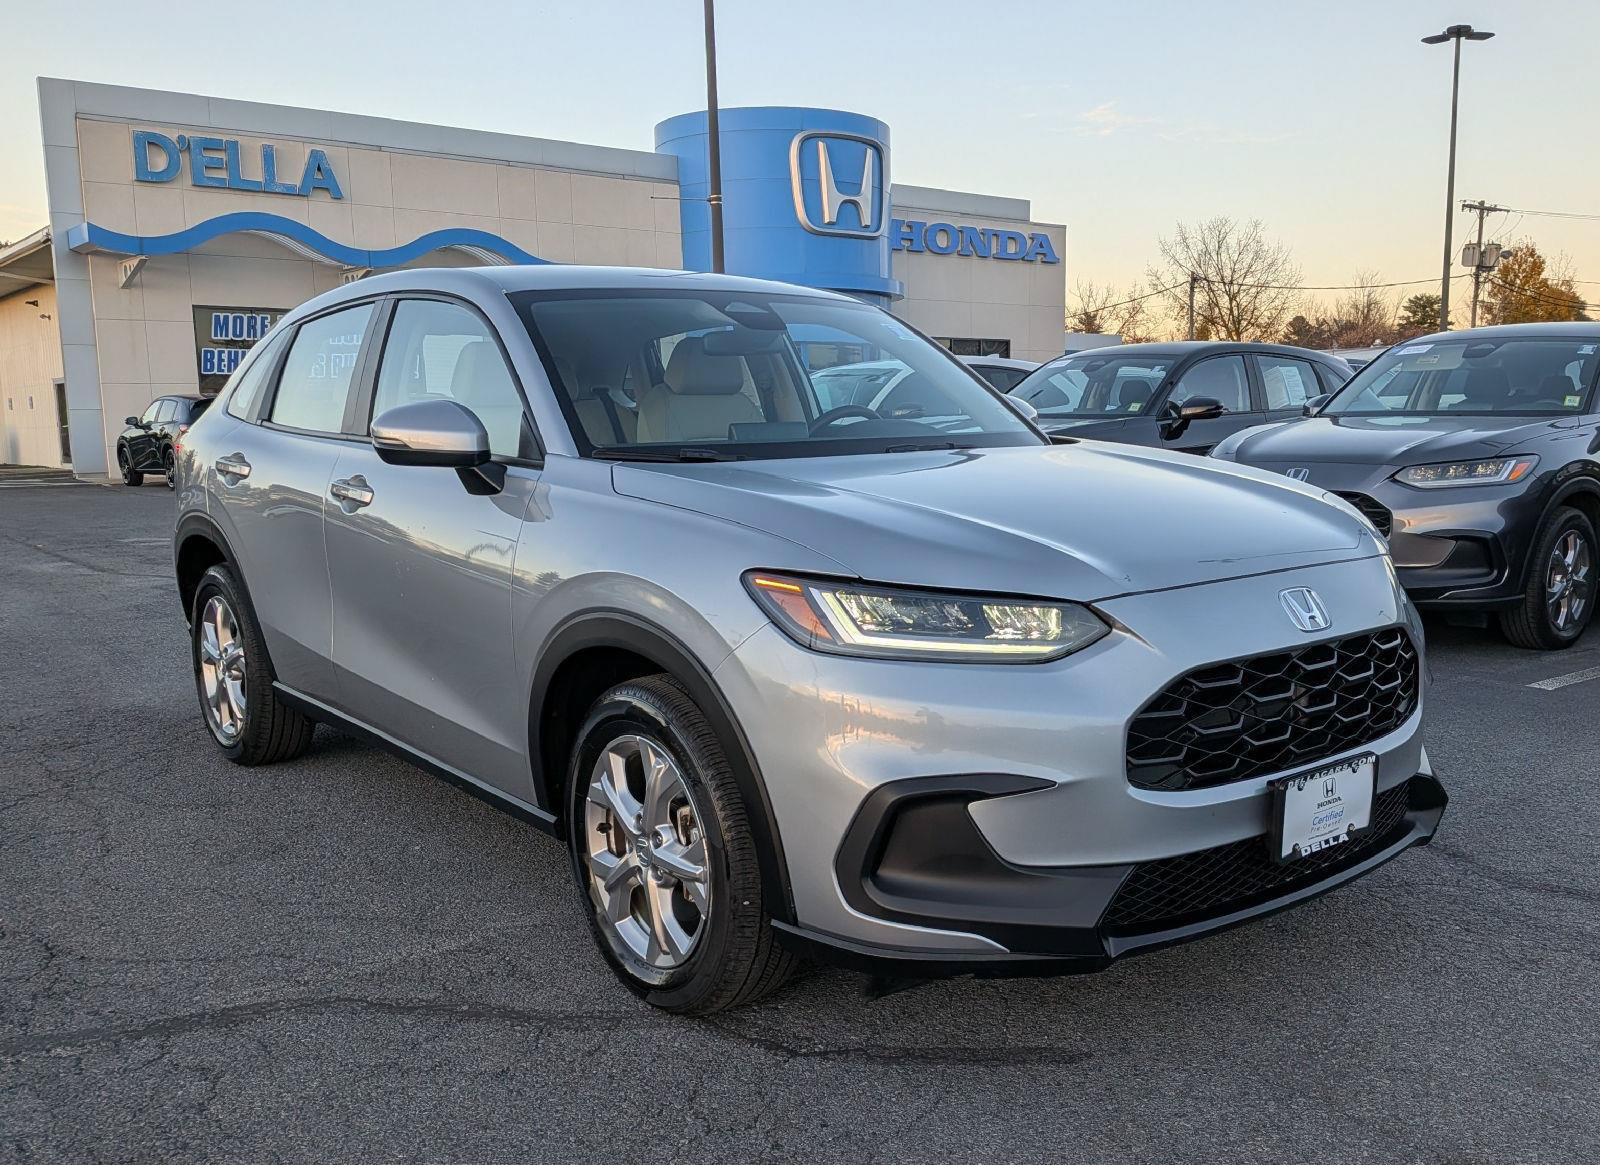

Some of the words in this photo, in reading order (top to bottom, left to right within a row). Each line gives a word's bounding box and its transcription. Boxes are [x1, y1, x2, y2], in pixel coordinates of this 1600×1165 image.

[132, 129, 344, 199] D'ELLA
[891, 218, 1060, 264] HONDA
[211, 312, 271, 341] MORE
[1316, 796, 1342, 809] HONDA
[1312, 806, 1344, 826] Certified
[1300, 833, 1349, 857] DELLA
